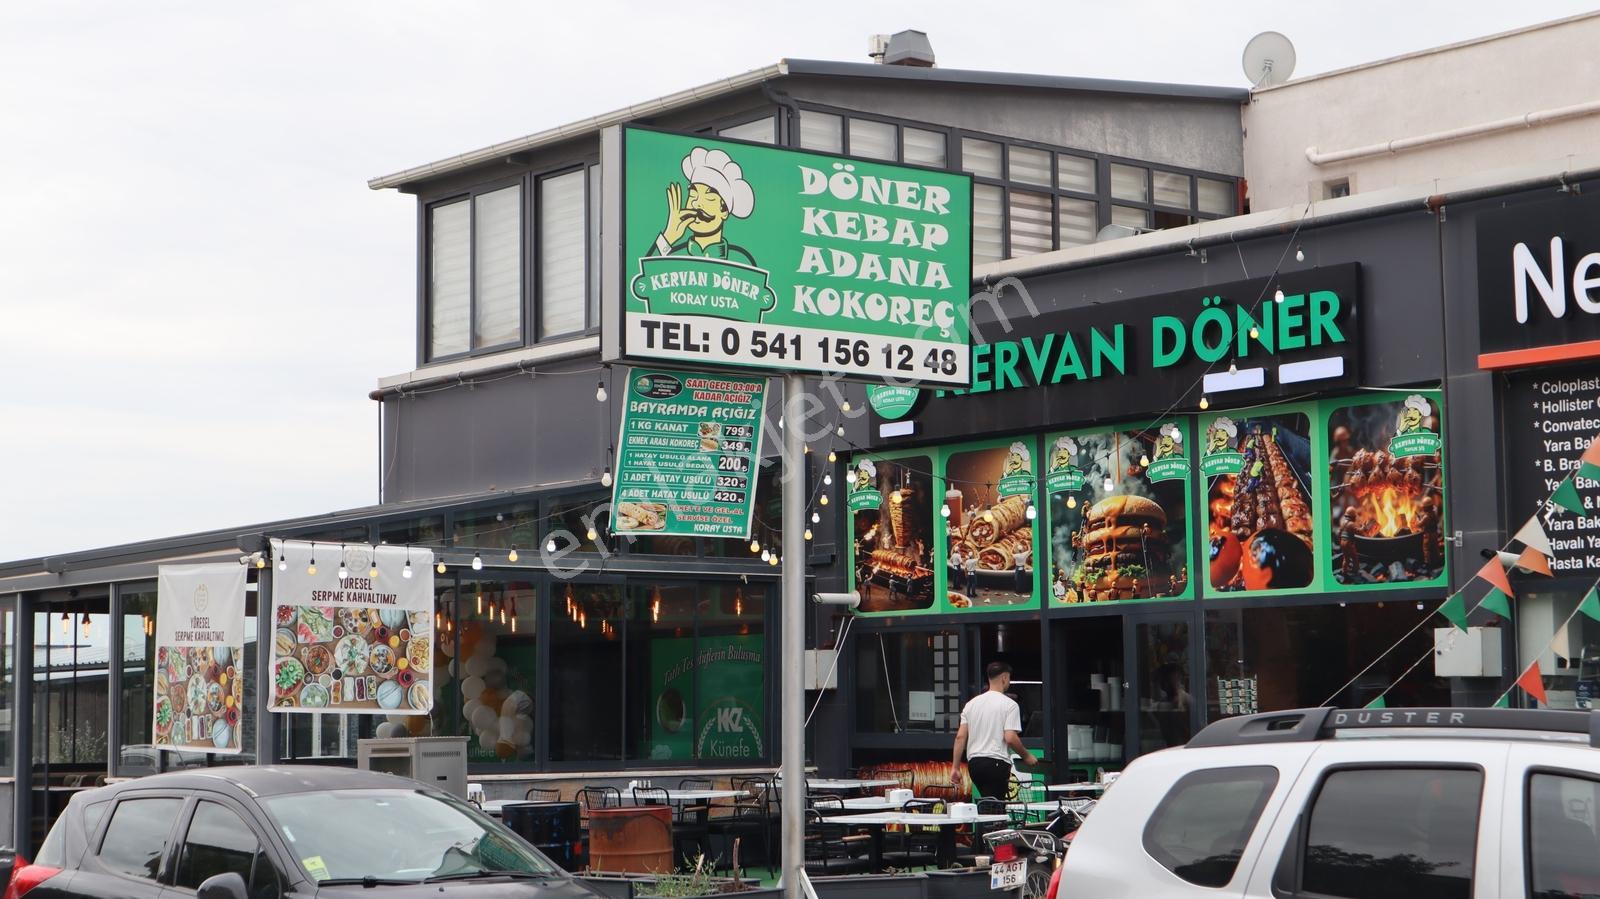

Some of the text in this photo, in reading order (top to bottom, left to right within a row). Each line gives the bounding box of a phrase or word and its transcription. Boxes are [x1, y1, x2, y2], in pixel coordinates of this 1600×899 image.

[797, 162, 950, 214] DÖNER
[800, 207, 949, 251] KEBAP
[796, 245, 952, 289] ADANA
[650, 271, 760, 300] KERVAN DÖNER
[1513, 236, 1600, 324] Ne
[670, 292, 739, 309] KORAY USTA
[792, 285, 955, 337] KOKOREÇ
[640, 320, 957, 376] TEL: 0 541 156 12 48
[936, 290, 1345, 397] ERVAN DÖNER
[686, 379, 708, 389] SAAT
[708, 380, 731, 391] GECE
[1541, 377, 1600, 395] Coloplast
[694, 391, 722, 402] KADAR
[630, 401, 756, 421] BAYRAMDA AÇIĞIZ
[1542, 398, 1594, 414] Hollister
[630, 421, 635, 429] 1
[638, 422, 651, 430] KG
[655, 422, 688, 432] KANAT
[725, 426, 745, 436] 799
[1543, 417, 1600, 433] Convatec
[628, 437, 649, 446] EKMEK
[651, 438, 668, 447] ARASI
[670, 439, 699, 449] KOKOREÇ
[721, 441, 743, 451] 349
[1544, 436, 1594, 453] Yara Ba
[718, 457, 741, 471] 200
[1544, 457, 1584, 472] B. Bra
[624, 473, 629, 481] 3
[630, 473, 651, 482] ADET
[653, 474, 680, 483] HATAY
[716, 477, 738, 487] 320
[628, 489, 650, 498] ADET
[651, 490, 678, 499] HATAY
[715, 492, 737, 502] 420
[694, 523, 743, 534] KORAY USTA
[1547, 518, 1574, 531] Yara
[1547, 556, 1583, 570] Hasta
[312, 590, 397, 605] SERPME KAHVALTIMIZ
[175, 631, 225, 642] SERPME KAHVALTIMIZ
[1335, 712, 1465, 724] DUSTER
[710, 738, 750, 757] Künefe
[994, 861, 1024, 874] 44 AGT
[1003, 874, 1016, 885] 156
